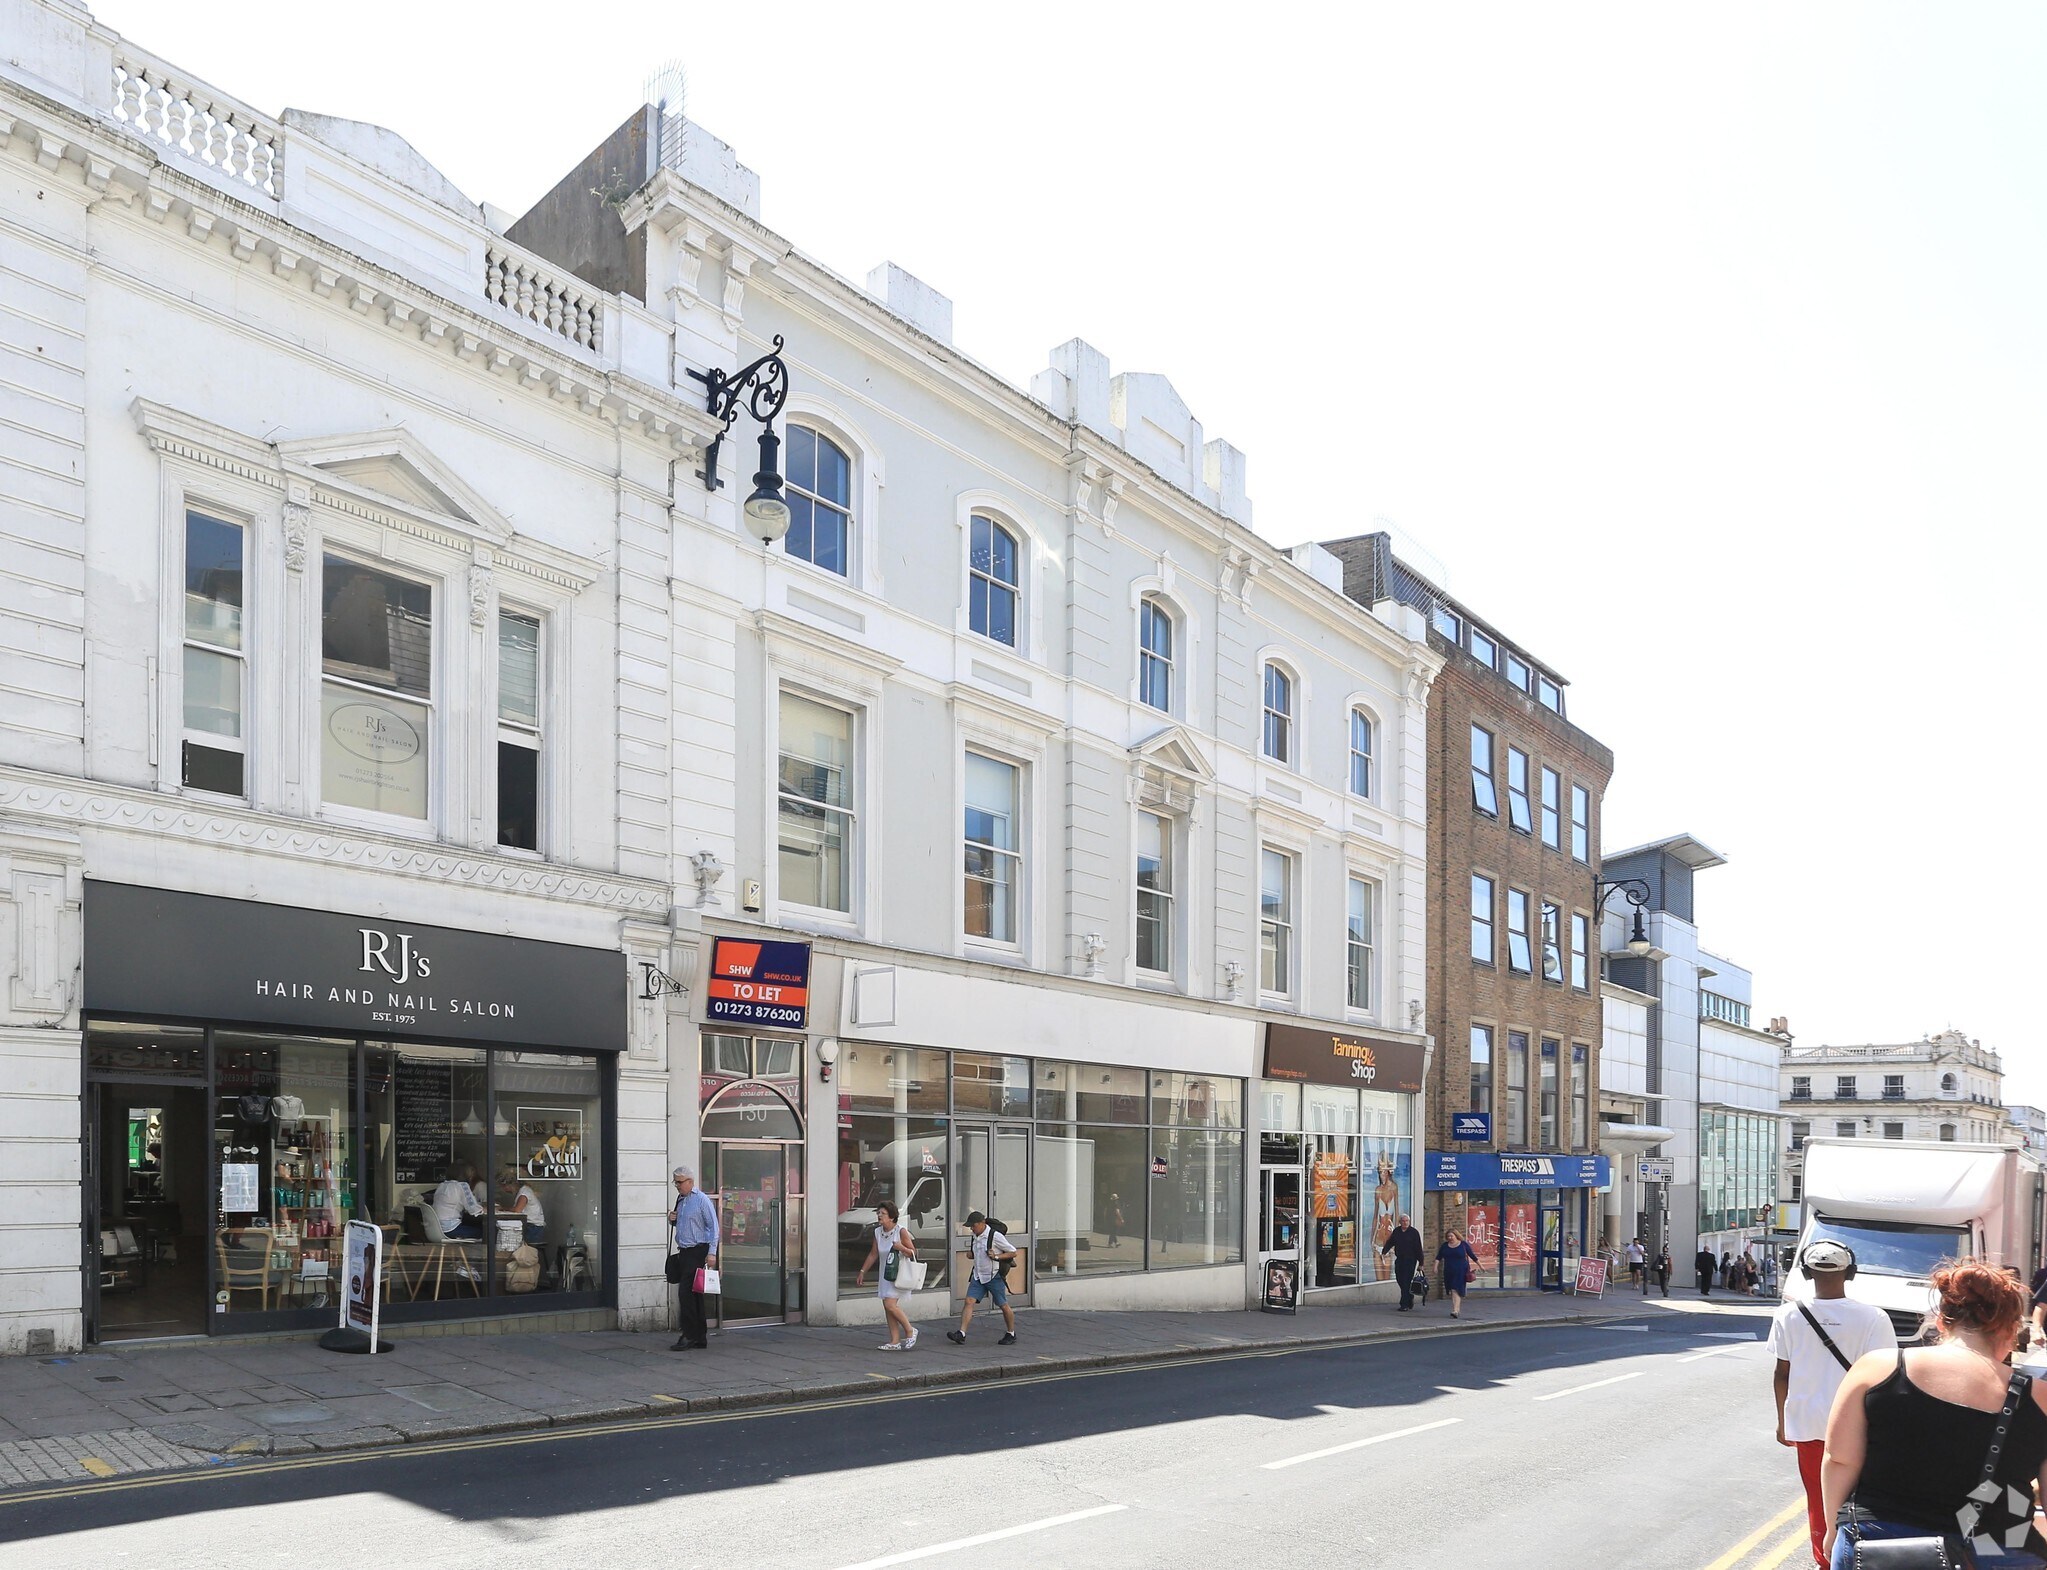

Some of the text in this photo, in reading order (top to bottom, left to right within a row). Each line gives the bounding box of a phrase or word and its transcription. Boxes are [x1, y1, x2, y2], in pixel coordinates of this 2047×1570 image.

[365, 716, 386, 732] RJ's
[373, 735, 388, 743] NAIL
[391, 738, 412, 748] SALON
[358, 928, 431, 984] RJ's
[728, 965, 752, 976] SHW
[763, 972, 802, 982] SHW.CO.UK
[256, 980, 516, 1018] HAIR AND NAIL SALON
[733, 983, 782, 1002] TO LET
[372, 1011, 416, 1025] EST. 1975
[714, 1001, 801, 1022] 01273 876200
[1332, 1037, 1368, 1064] Tanning
[1351, 1059, 1375, 1084] Shop
[737, 1103, 767, 1121] 130
[543, 1141, 580, 1165] Nail
[527, 1158, 579, 1178] Crew
[1500, 1158, 1537, 1173] TRESPASS
[1469, 1223, 1494, 1244] SALE
[1510, 1220, 1532, 1241] SALE
[1580, 1265, 1604, 1276] SALE
[1579, 1275, 1602, 1288] 70%
